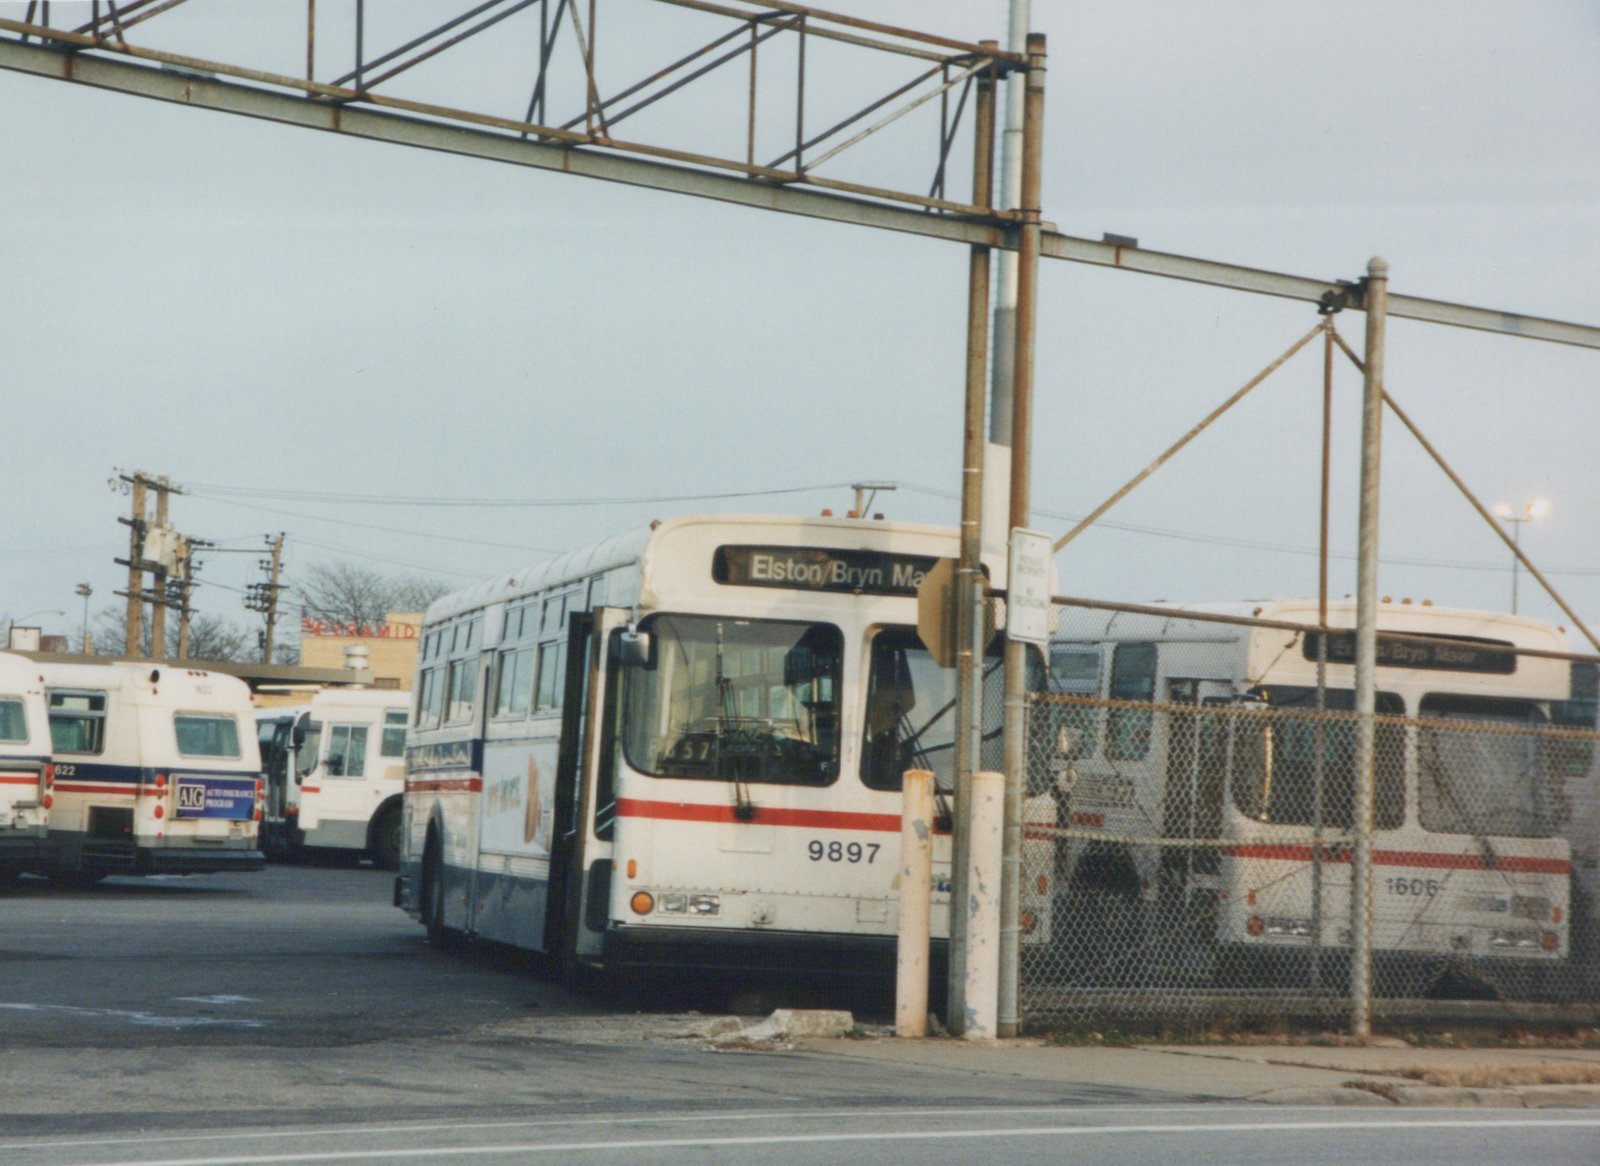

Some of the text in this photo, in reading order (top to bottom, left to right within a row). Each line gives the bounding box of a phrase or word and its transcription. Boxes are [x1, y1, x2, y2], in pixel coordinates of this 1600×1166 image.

[316, 621, 415, 639] PYRAMID
[180, 787, 204, 807] AIG
[808, 840, 881, 864] 9897
